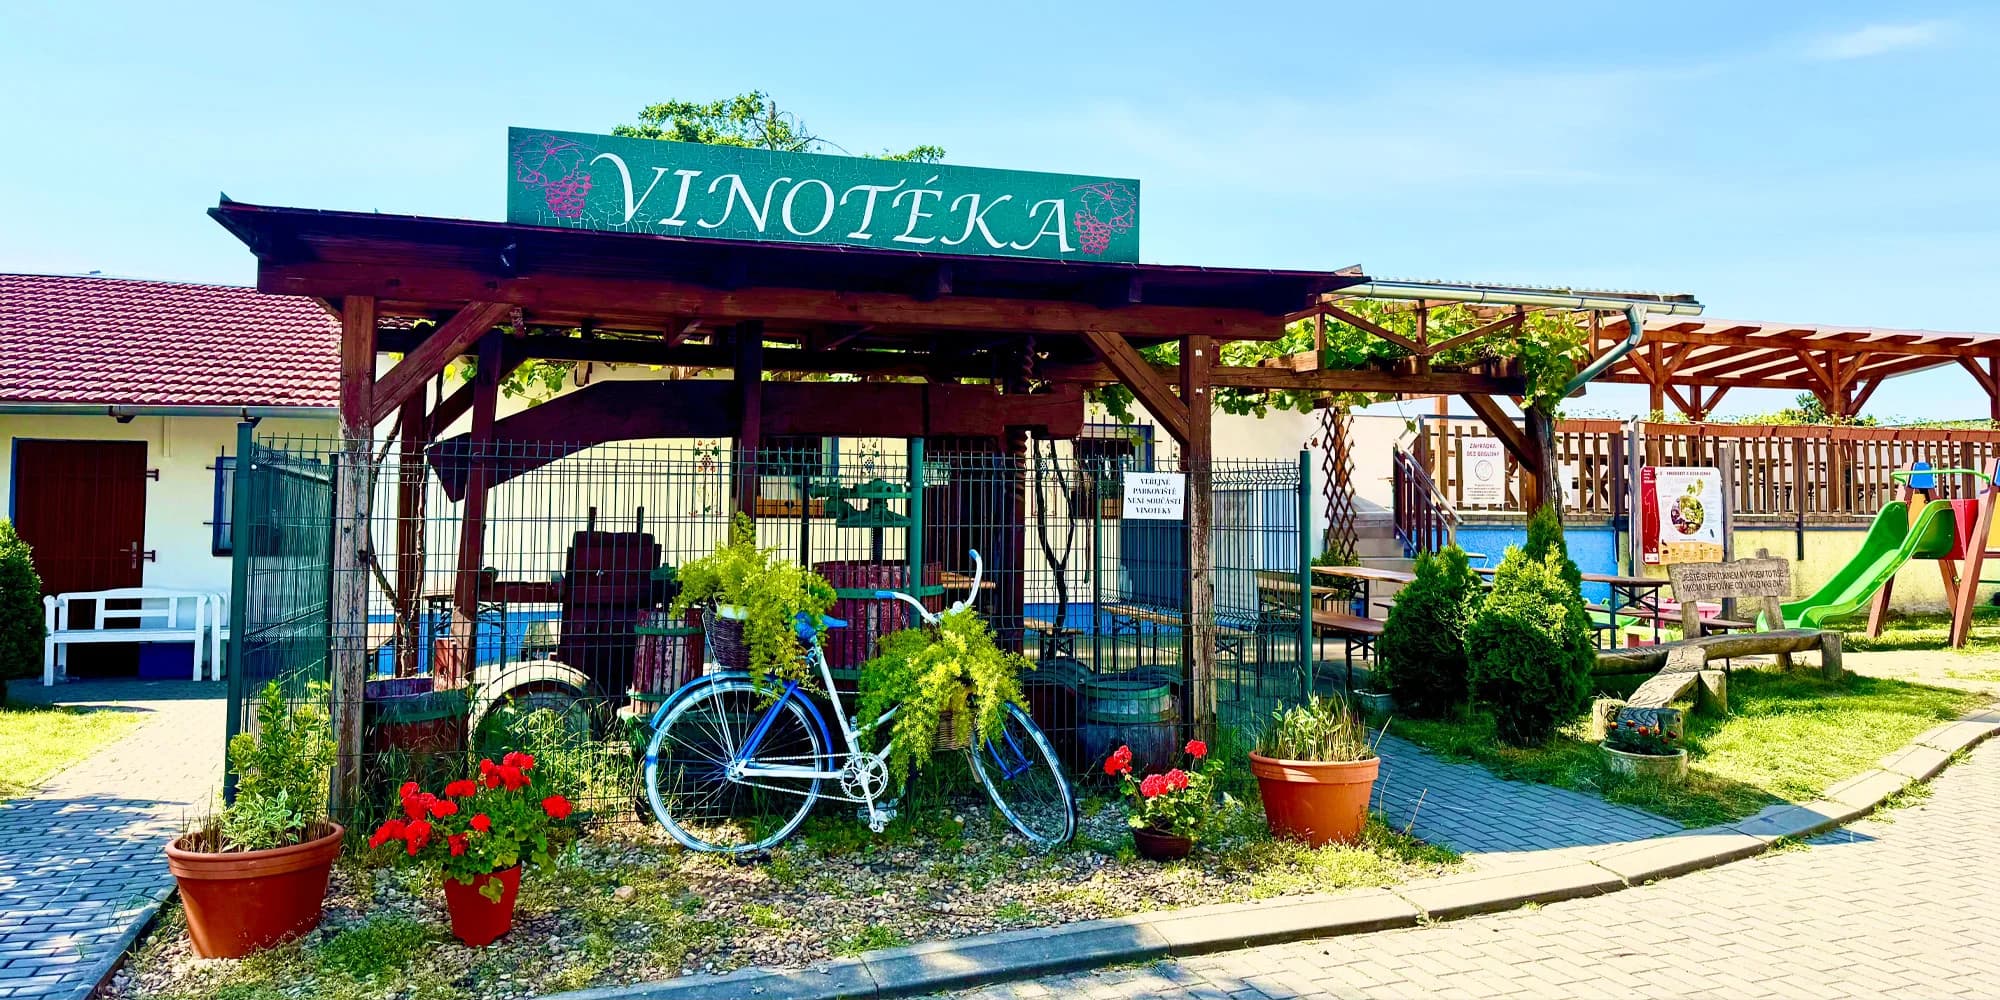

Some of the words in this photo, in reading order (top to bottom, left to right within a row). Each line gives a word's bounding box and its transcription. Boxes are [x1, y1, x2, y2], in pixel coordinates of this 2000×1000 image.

[590, 152, 1076, 254] VINOTÉKA
[1133, 487, 1177, 495] PARKOVIŠTĚ
[1127, 496, 1144, 504] NENÍ
